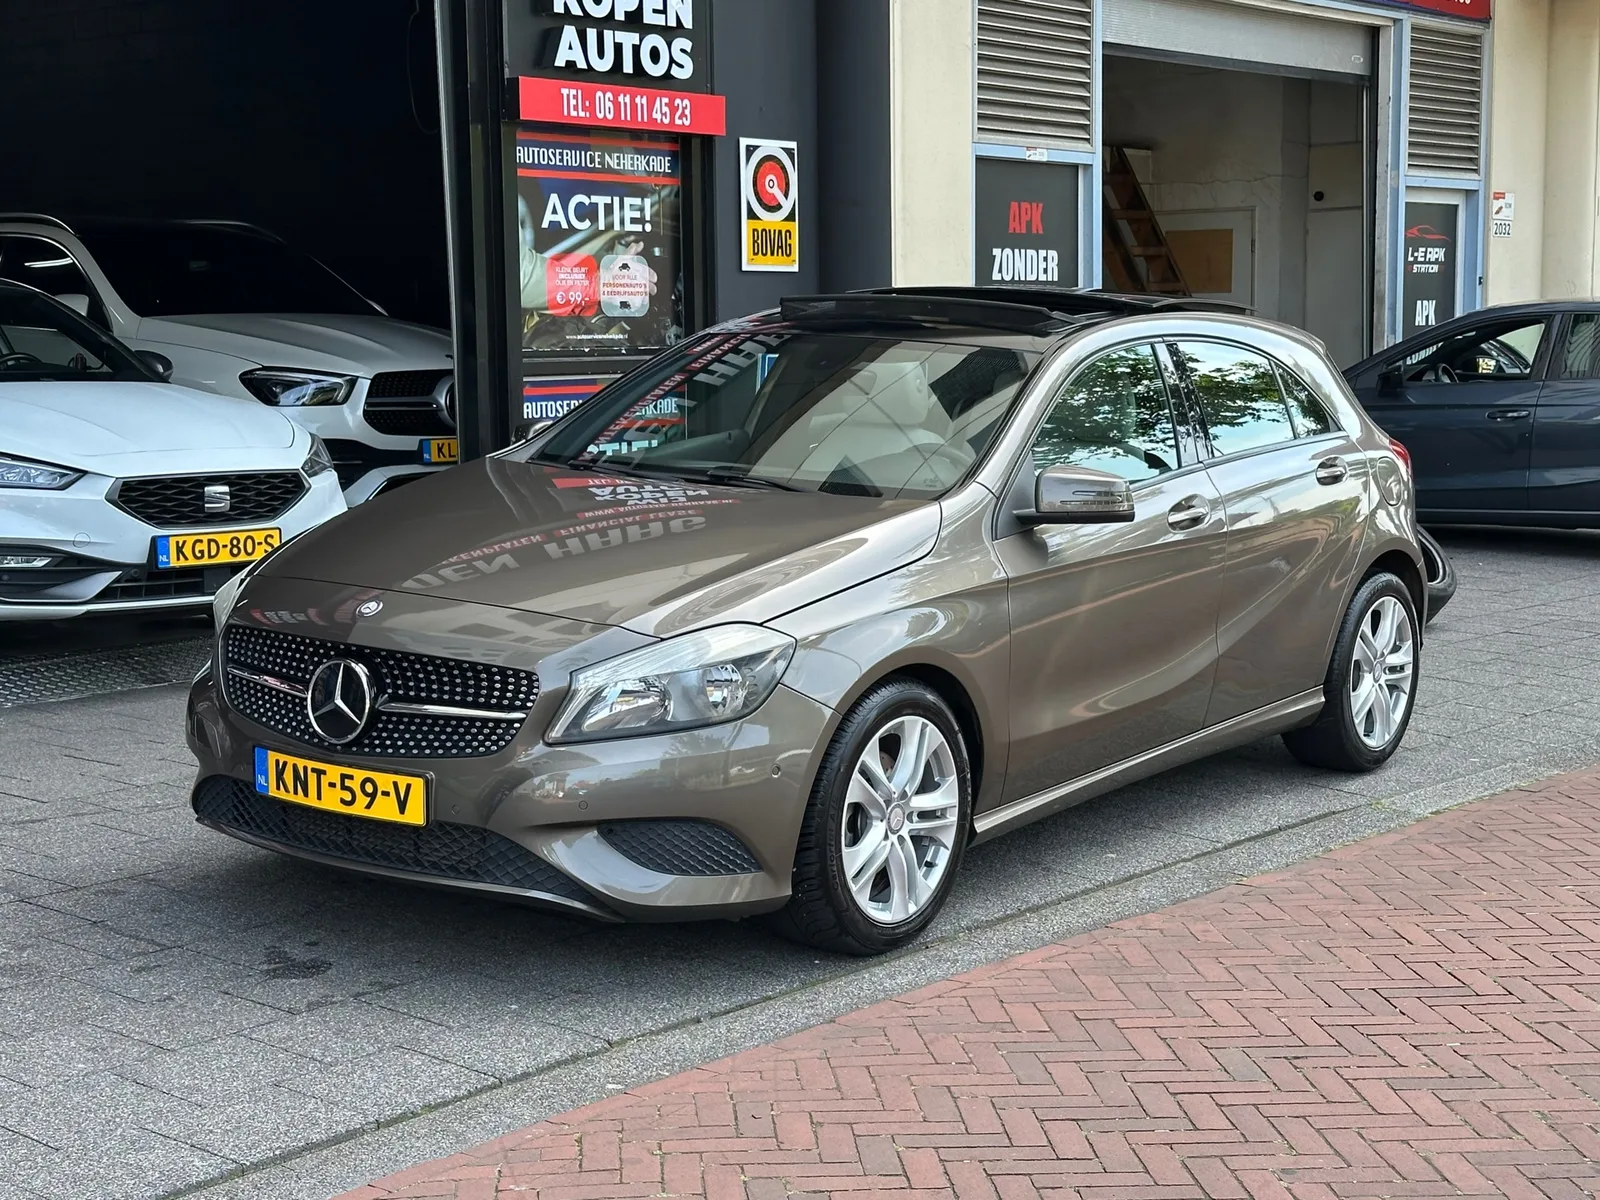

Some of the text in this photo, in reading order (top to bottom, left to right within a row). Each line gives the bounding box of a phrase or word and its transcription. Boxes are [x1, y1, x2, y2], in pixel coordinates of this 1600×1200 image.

[554, 25, 694, 80] AUTOS
[561, 88, 691, 126] TEL: 06 11 11 45 23
[516, 146, 672, 173] AUTOSERVICE NEHERKADE
[541, 193, 652, 233] ACTIE!
[1008, 201, 1044, 234] APK
[752, 228, 792, 258] BOVAG
[1494, 222, 1511, 236] 2032
[992, 248, 1059, 282] ZONDER
[1407, 247, 1446, 262] L-E APK
[1412, 264, 1439, 273] STATION
[556, 291, 566, 304] €
[1415, 300, 1436, 326] APK
[175, 534, 276, 562] KGD-80-S
[257, 758, 412, 815] NL KNT-59-V
